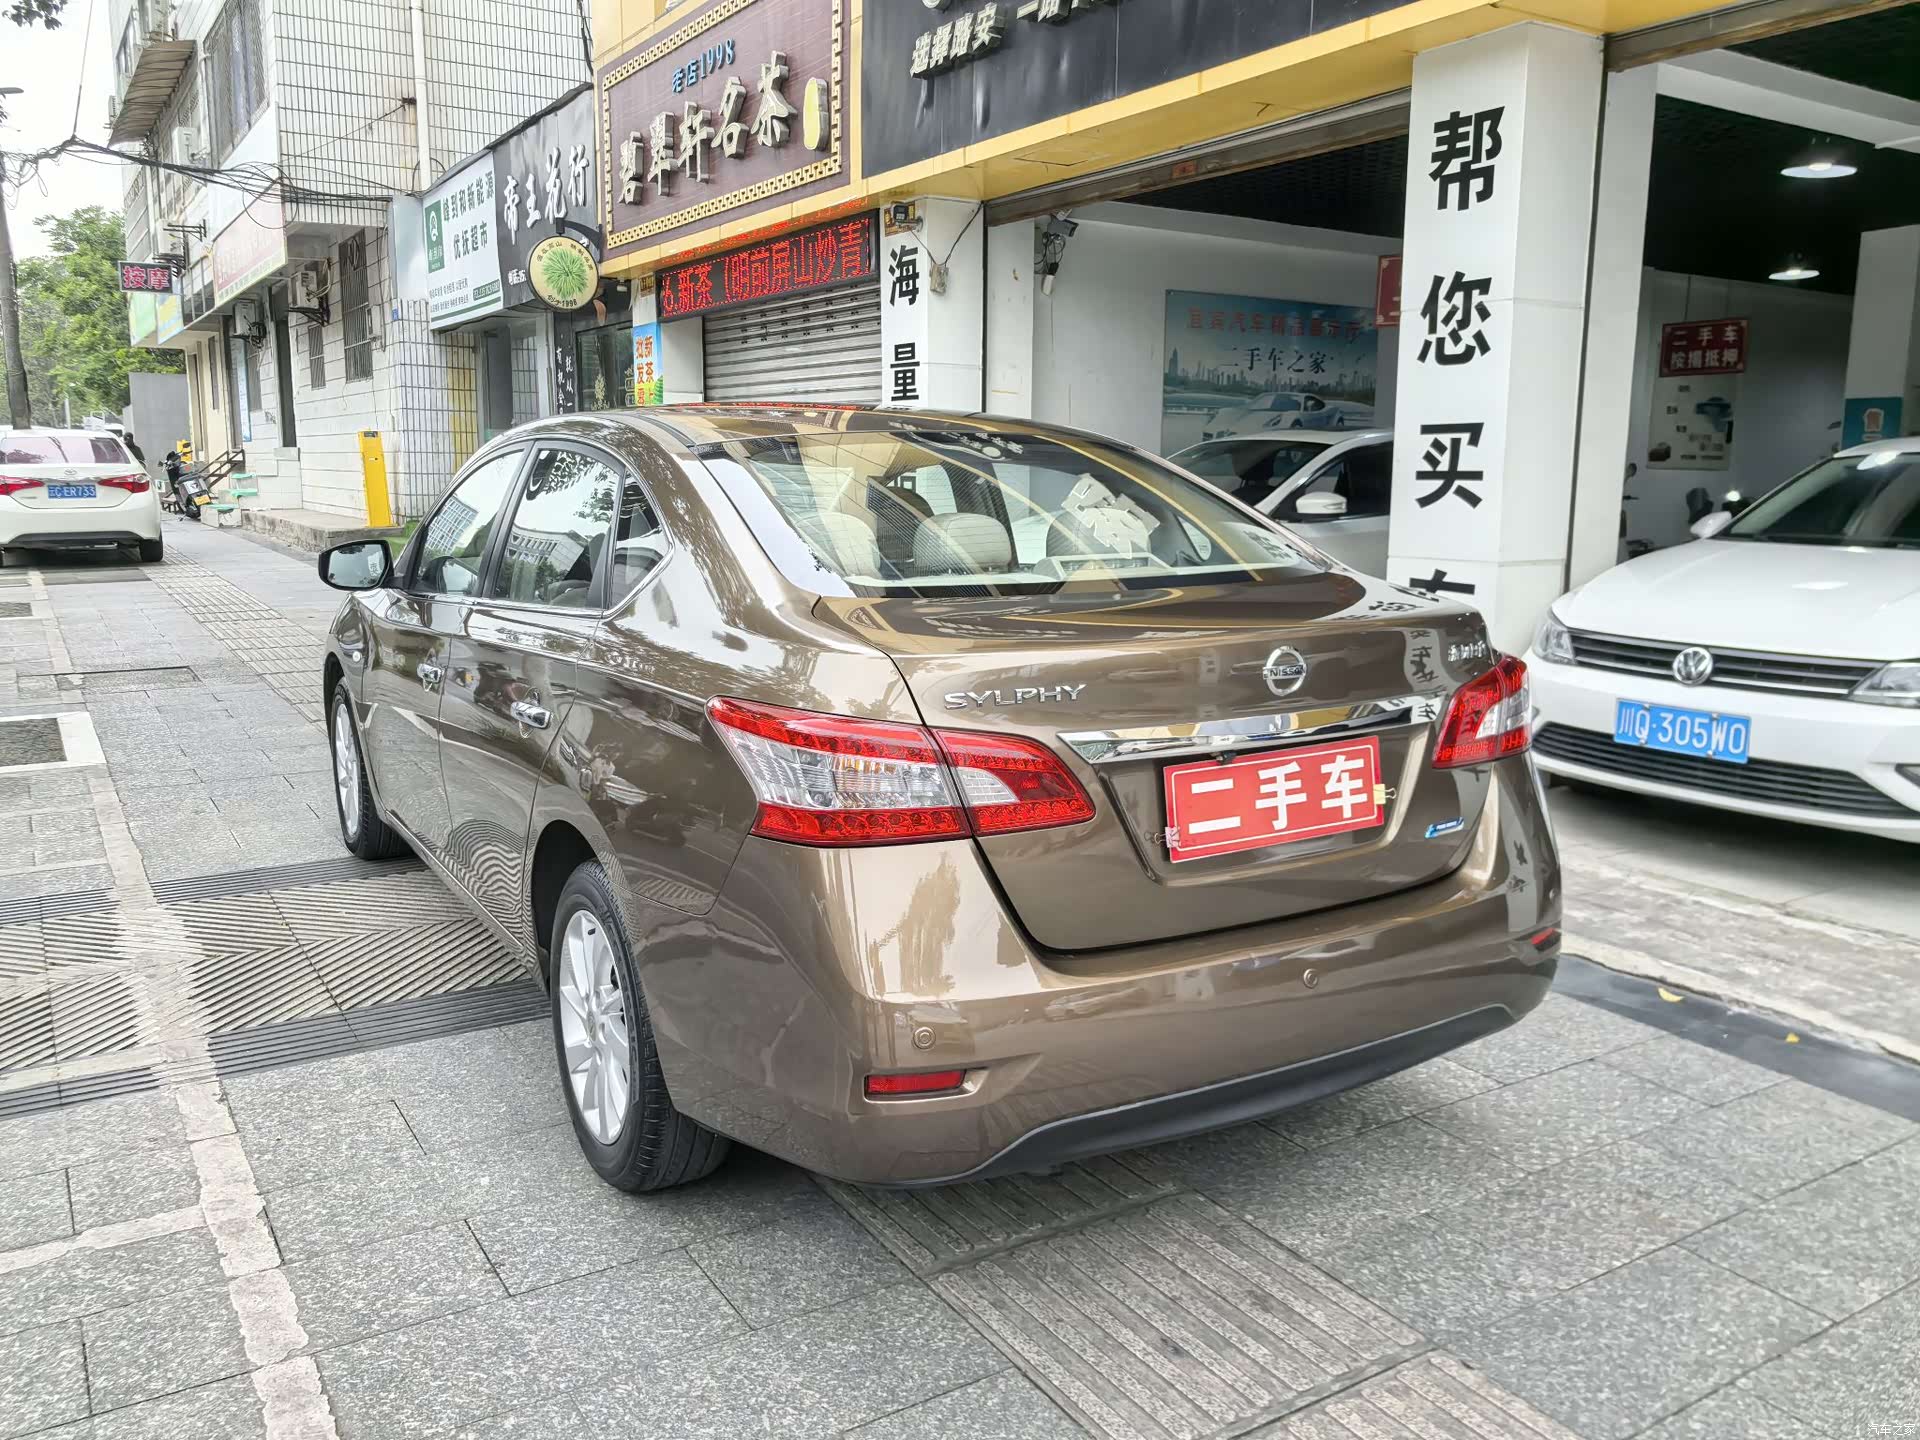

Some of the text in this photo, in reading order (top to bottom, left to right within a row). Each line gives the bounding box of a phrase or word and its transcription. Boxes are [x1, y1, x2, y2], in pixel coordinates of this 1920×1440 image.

[910, 2, 1002, 78] 选择路安
[672, 38, 735, 96] 老店1998
[123, 266, 170, 289] 按摩
[1672, 325, 1739, 346] 二手车
[943, 684, 1087, 710] SYLPHY
[1188, 755, 1367, 834] 二手车
